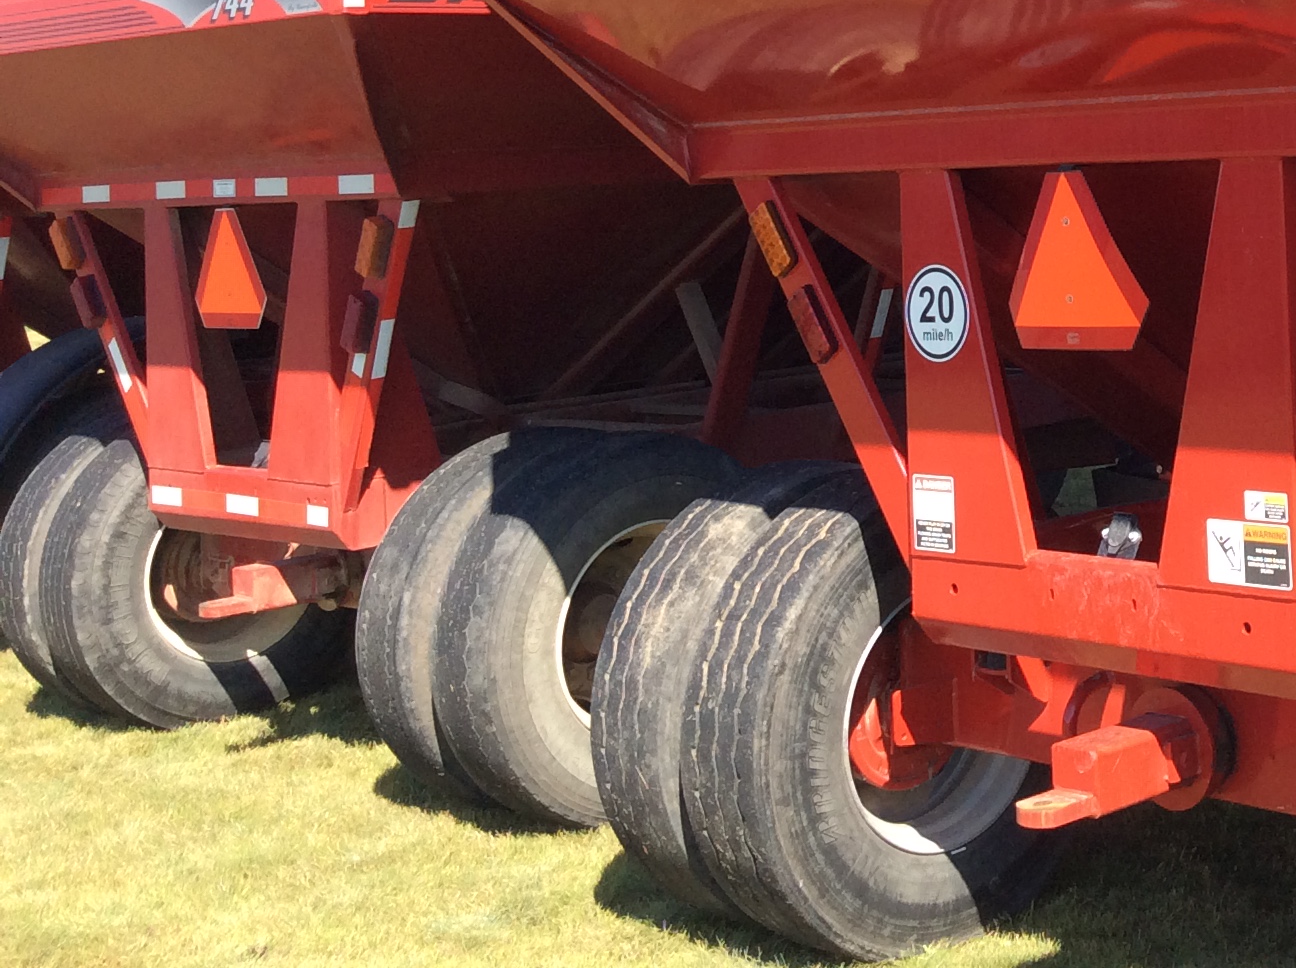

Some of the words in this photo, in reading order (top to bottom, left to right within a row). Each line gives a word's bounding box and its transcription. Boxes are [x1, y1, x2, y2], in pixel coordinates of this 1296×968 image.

[919, 285, 954, 323] 20
[922, 328, 954, 342] mile/h
[1252, 529, 1287, 541] WARNING
